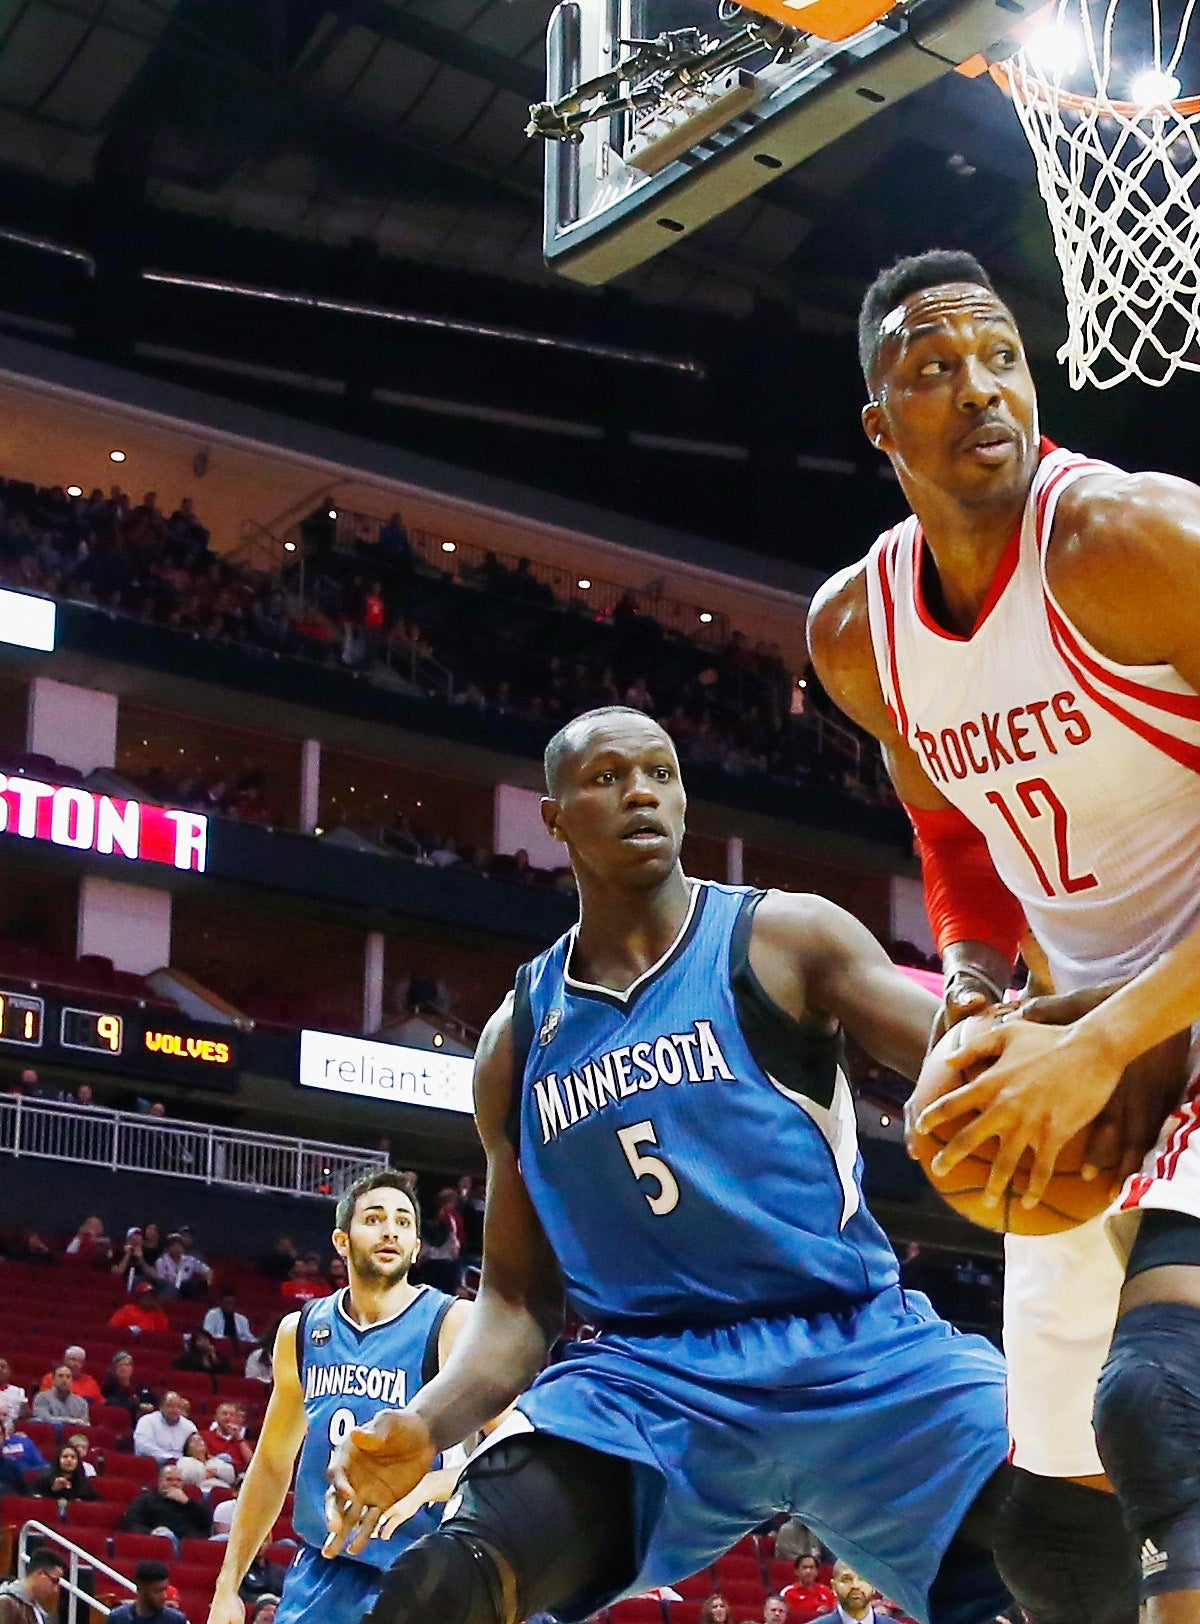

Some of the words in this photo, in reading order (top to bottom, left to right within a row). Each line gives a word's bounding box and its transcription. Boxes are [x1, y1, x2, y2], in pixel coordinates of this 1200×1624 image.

[914, 690, 1092, 784] ROCKETS
[0, 773, 140, 860] TON
[984, 777, 1099, 897] 12
[97, 1014, 120, 1052] 9
[145, 1030, 230, 1064] WOLVES
[324, 1056, 432, 1096] reliant
[533, 1020, 736, 1145] MINNESOTA
[616, 1120, 680, 1216] 5
[304, 1364, 407, 1408] MINNESOTA
